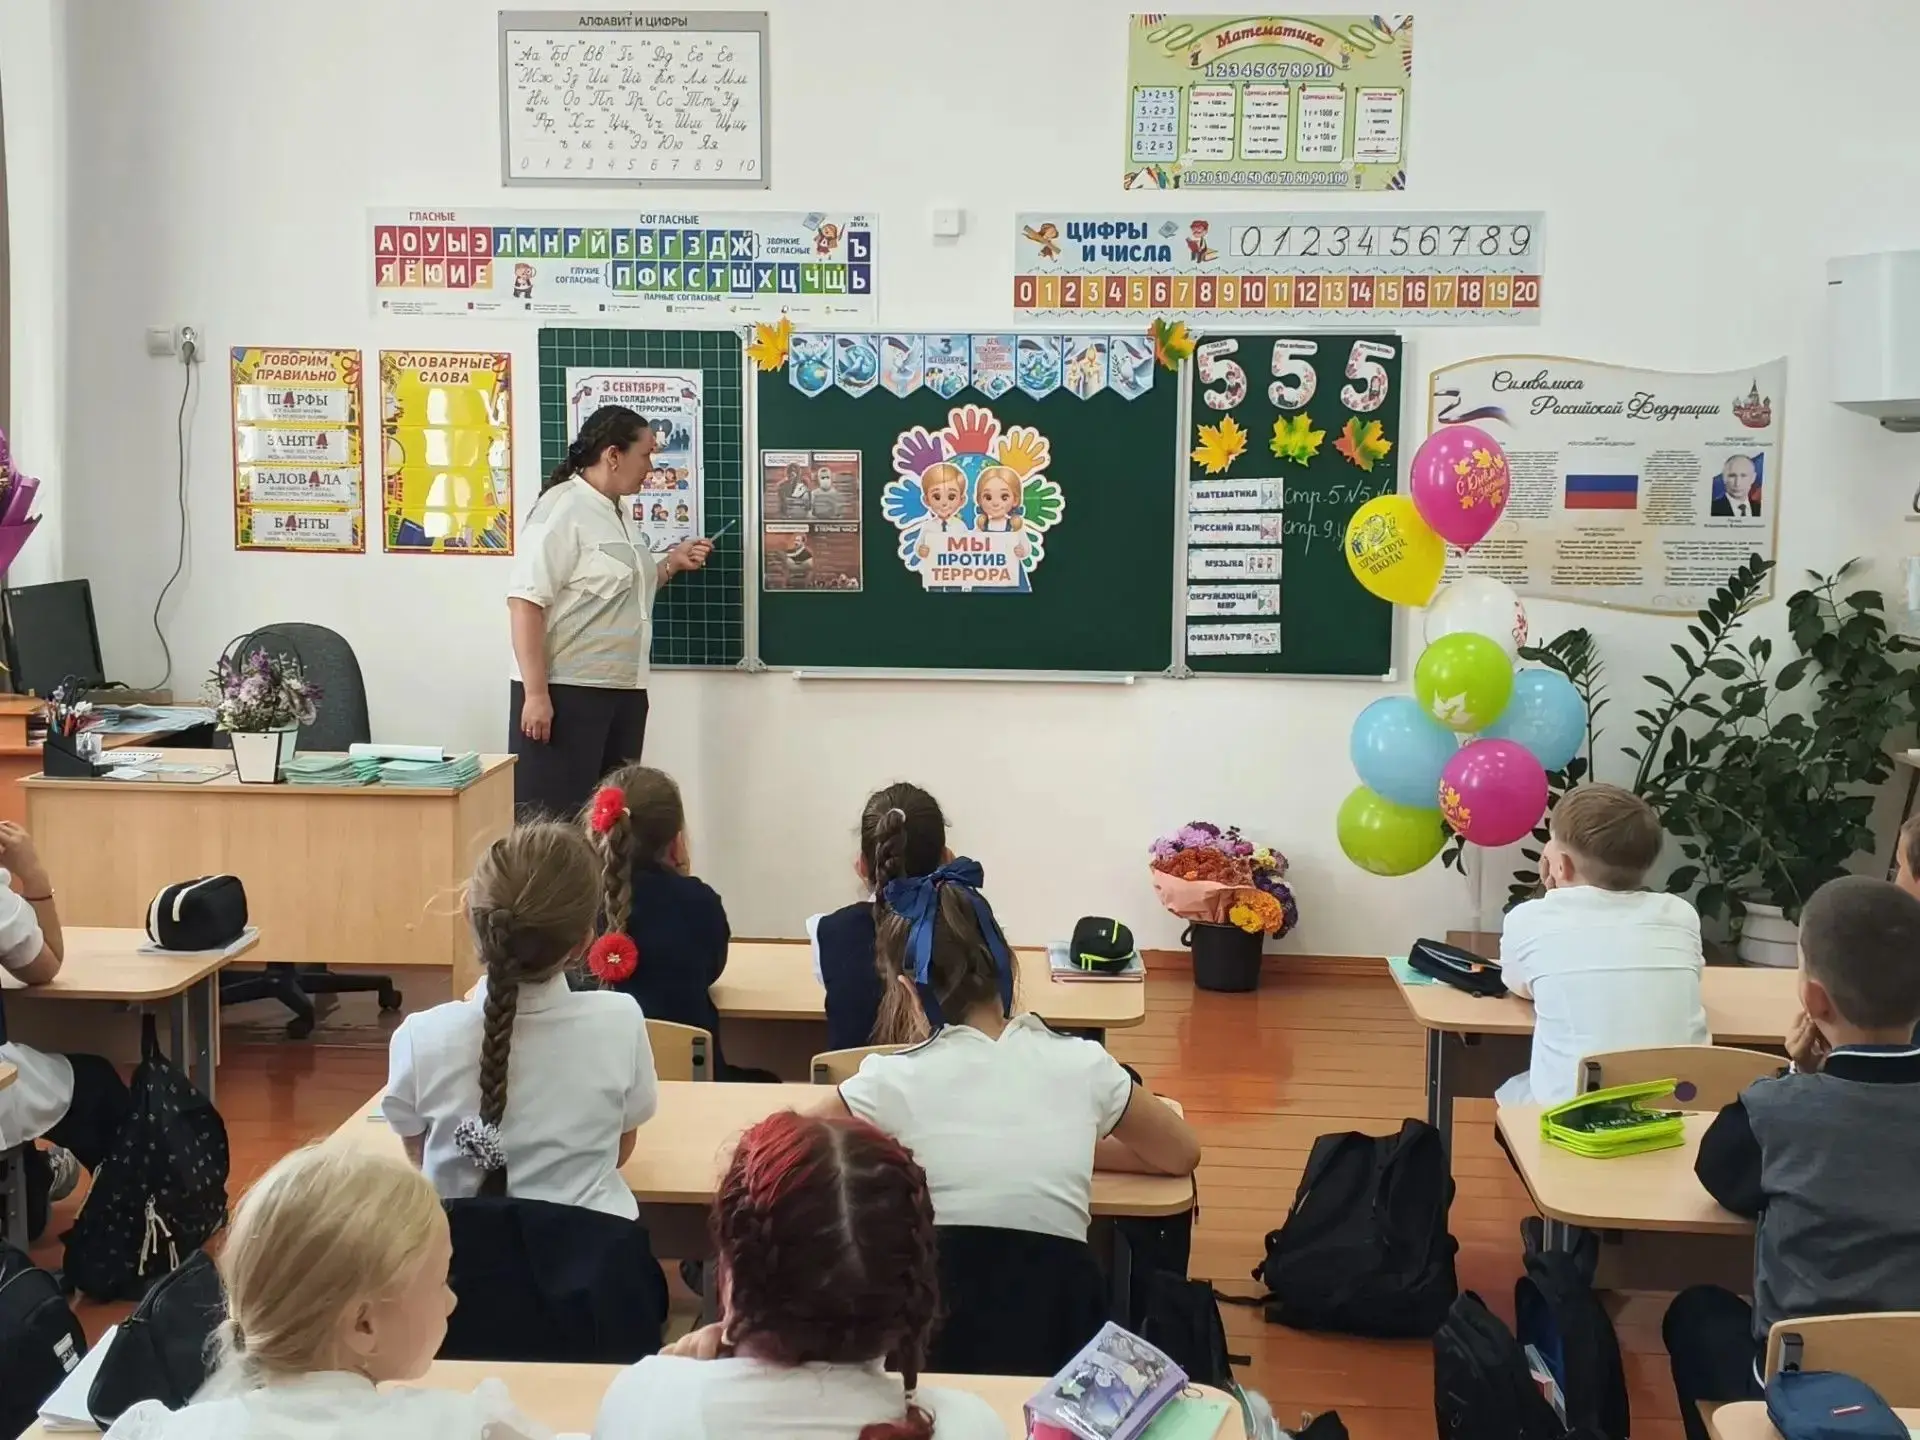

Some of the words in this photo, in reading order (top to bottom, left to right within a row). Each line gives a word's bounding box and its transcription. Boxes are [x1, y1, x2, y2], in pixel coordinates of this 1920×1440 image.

[579, 17, 631, 27] АЛФАВИТ
[635, 17, 643, 27] И
[646, 17, 688, 28] ЦИФРЫ
[1216, 24, 1324, 50] Математика
[409, 212, 456, 222] ГЛАСНЫЕ
[640, 214, 700, 224] СОГЛАСНЫЕ
[1066, 222, 1148, 242] ЦИФРЫ
[379, 232, 394, 252] А
[402, 233, 417, 252] О
[423, 233, 440, 252] У
[448, 234, 466, 252] Ы
[476, 234, 487, 252] Э
[497, 235, 512, 253] Л
[520, 235, 536, 253] М
[545, 236, 558, 253] Н
[568, 236, 580, 253] Р
[591, 232, 606, 253] Й
[616, 236, 630, 254] Б
[640, 236, 652, 254] В
[664, 236, 676, 254] Г
[688, 236, 700, 254] З
[710, 236, 726, 259] Д
[732, 237, 751, 256] Ж
[1240, 226, 1260, 256] 0
[1274, 226, 1291, 256] 1
[1302, 226, 1320, 256] 2
[1327, 226, 1350, 256] 3
[1358, 226, 1373, 256] 4
[1390, 226, 1410, 256] 5
[1418, 226, 1440, 256] 6
[1448, 226, 1470, 256] 7
[1480, 226, 1500, 256] 8
[1510, 226, 1530, 256] 9
[766, 246, 811, 254] СОГЛАСНЫЕ
[850, 240, 867, 258] Ъ
[1082, 245, 1094, 262] И
[1101, 245, 1171, 262] ЧИСЛА
[381, 264, 394, 282] Я
[406, 260, 416, 282] Ё
[424, 264, 442, 282] Ю
[450, 264, 465, 282] И
[476, 265, 487, 283] Е
[556, 276, 600, 284] СОГЛАСНЫЕ
[616, 266, 630, 284] П
[638, 265, 656, 286] Ф
[663, 268, 676, 286] К
[688, 268, 700, 286] С
[712, 268, 724, 286] Т
[732, 268, 750, 286] Ш
[760, 268, 772, 287] Х
[782, 269, 796, 292] Ц
[806, 269, 818, 288] Ч
[826, 270, 845, 292] Щ
[852, 272, 866, 288] Ь
[644, 293, 675, 301] ПАРНЫЕ
[677, 293, 720, 302] СОГЛАСНЫЕ
[1020, 282, 1032, 302] 0
[1044, 282, 1052, 302] 1
[1065, 282, 1076, 302] 2
[1088, 282, 1098, 302] 3
[1109, 282, 1122, 302] 4
[1133, 282, 1144, 302] 5
[1155, 282, 1166, 302] 6
[1178, 282, 1189, 302] 7
[1200, 282, 1212, 302] 8
[1223, 282, 1234, 302] 9
[1244, 282, 1263, 302] 10
[1273, 282, 1288, 302] 11
[1298, 282, 1316, 302] 12
[1325, 282, 1344, 302] 13
[1352, 282, 1371, 302] 14
[1379, 282, 1398, 302] 15
[1406, 282, 1426, 302] 16
[1434, 282, 1453, 302] 17
[1461, 282, 1480, 302] 18
[1490, 282, 1508, 302] 19
[1514, 282, 1538, 302] 20
[940, 338, 952, 354] 3
[264, 354, 328, 366] ГОВОРИМ
[398, 356, 492, 369] СЛОВАРНЫЕ
[256, 369, 336, 382] ПРАВИЛЬНО
[419, 372, 470, 383] СЛОВА
[1197, 338, 1247, 410] 5
[1268, 339, 1318, 410] 5
[1340, 340, 1396, 412] 5
[1492, 369, 1584, 393] Символика
[603, 380, 610, 392] 3
[612, 382, 665, 392] СЕНТЯБРЯ
[599, 395, 618, 403] ДЕНЬ
[620, 395, 680, 403] СОЛИДАРНОСТИ
[1530, 396, 1622, 416] Российской
[1196, 490, 1258, 499] МАТЕМАТИКА
[1194, 522, 1233, 531] РУССКИЙ
[1235, 524, 1260, 532] ЯЗЫК
[948, 537, 990, 552] МЫ
[938, 554, 1006, 566] ПРОТИВ
[932, 568, 1011, 580] ТЕРРОРА
[1190, 592, 1258, 600] ОКРУЖАЮЩИЙ
[1190, 633, 1252, 641] ФИЗКУЛЬТУРА
